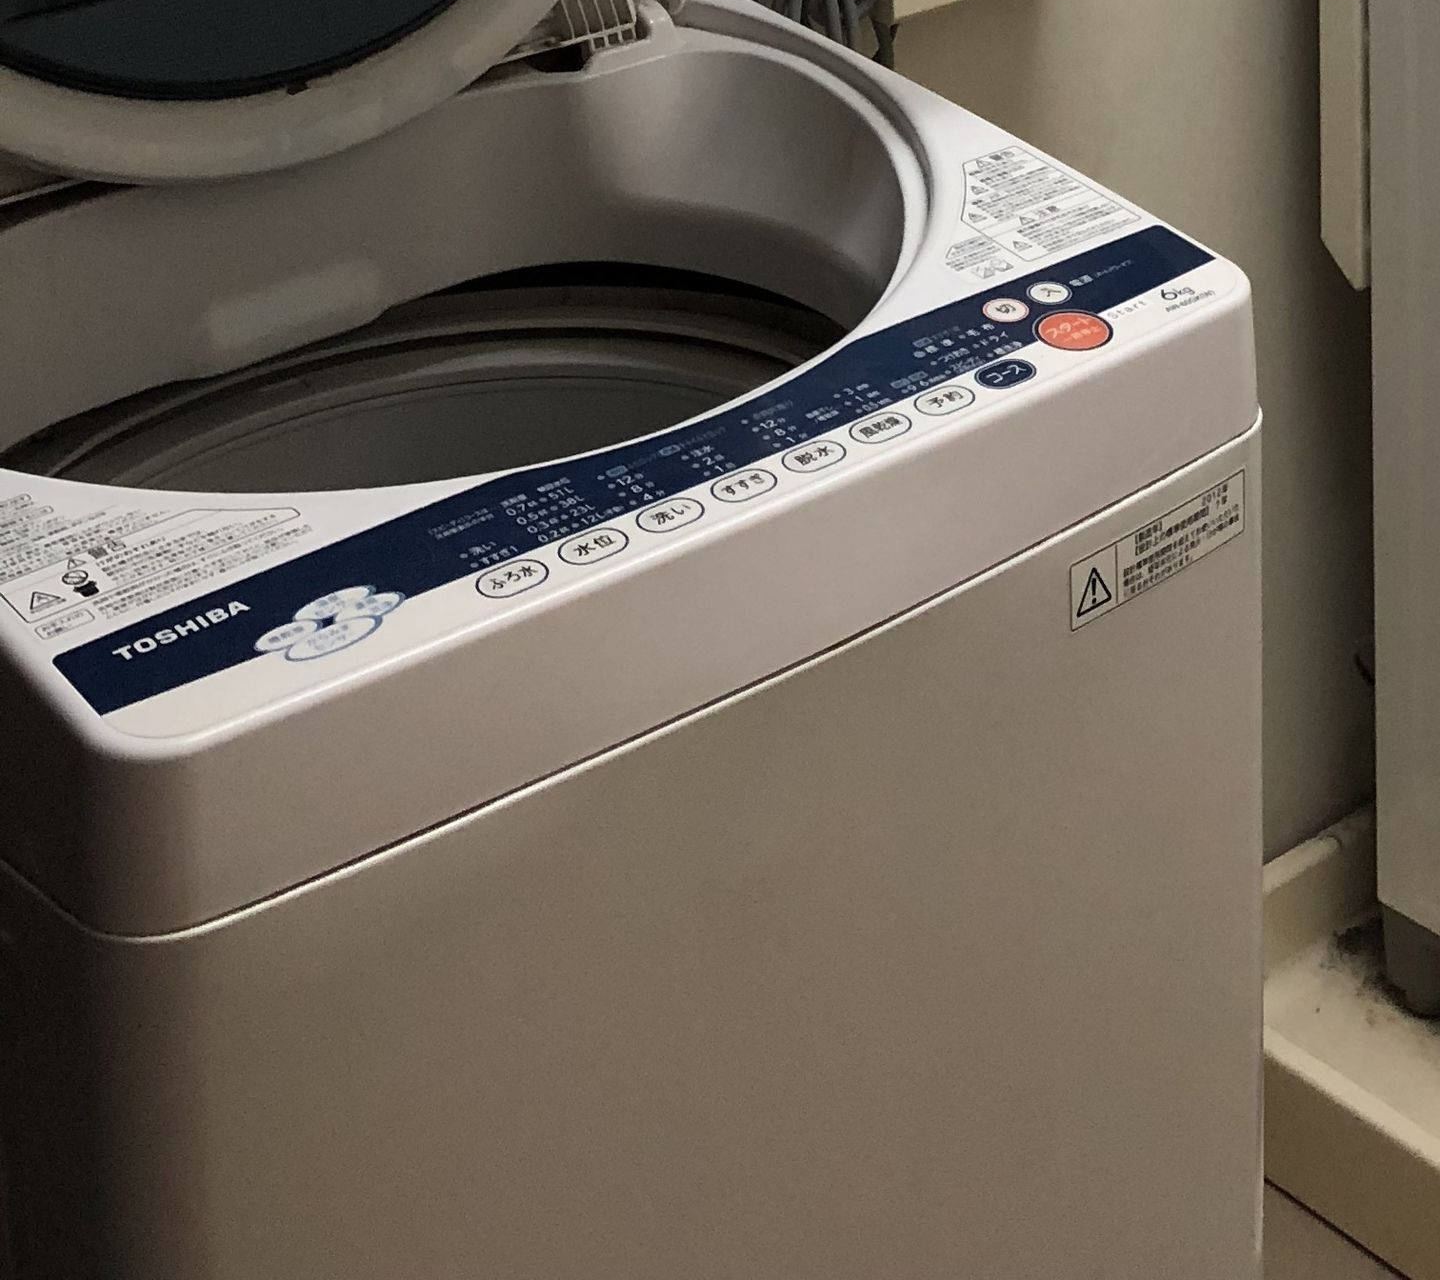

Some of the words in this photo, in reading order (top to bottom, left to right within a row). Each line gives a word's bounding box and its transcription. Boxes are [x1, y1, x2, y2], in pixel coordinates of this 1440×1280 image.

[1160, 285, 1196, 303] 6kg
[985, 364, 1028, 385] コース
[794, 444, 835, 467] 脱水
[651, 503, 692, 526] 洗い
[572, 534, 616, 559] 水位
[490, 565, 539, 591] ふろ水
[111, 599, 251, 662] TOSHIBA
